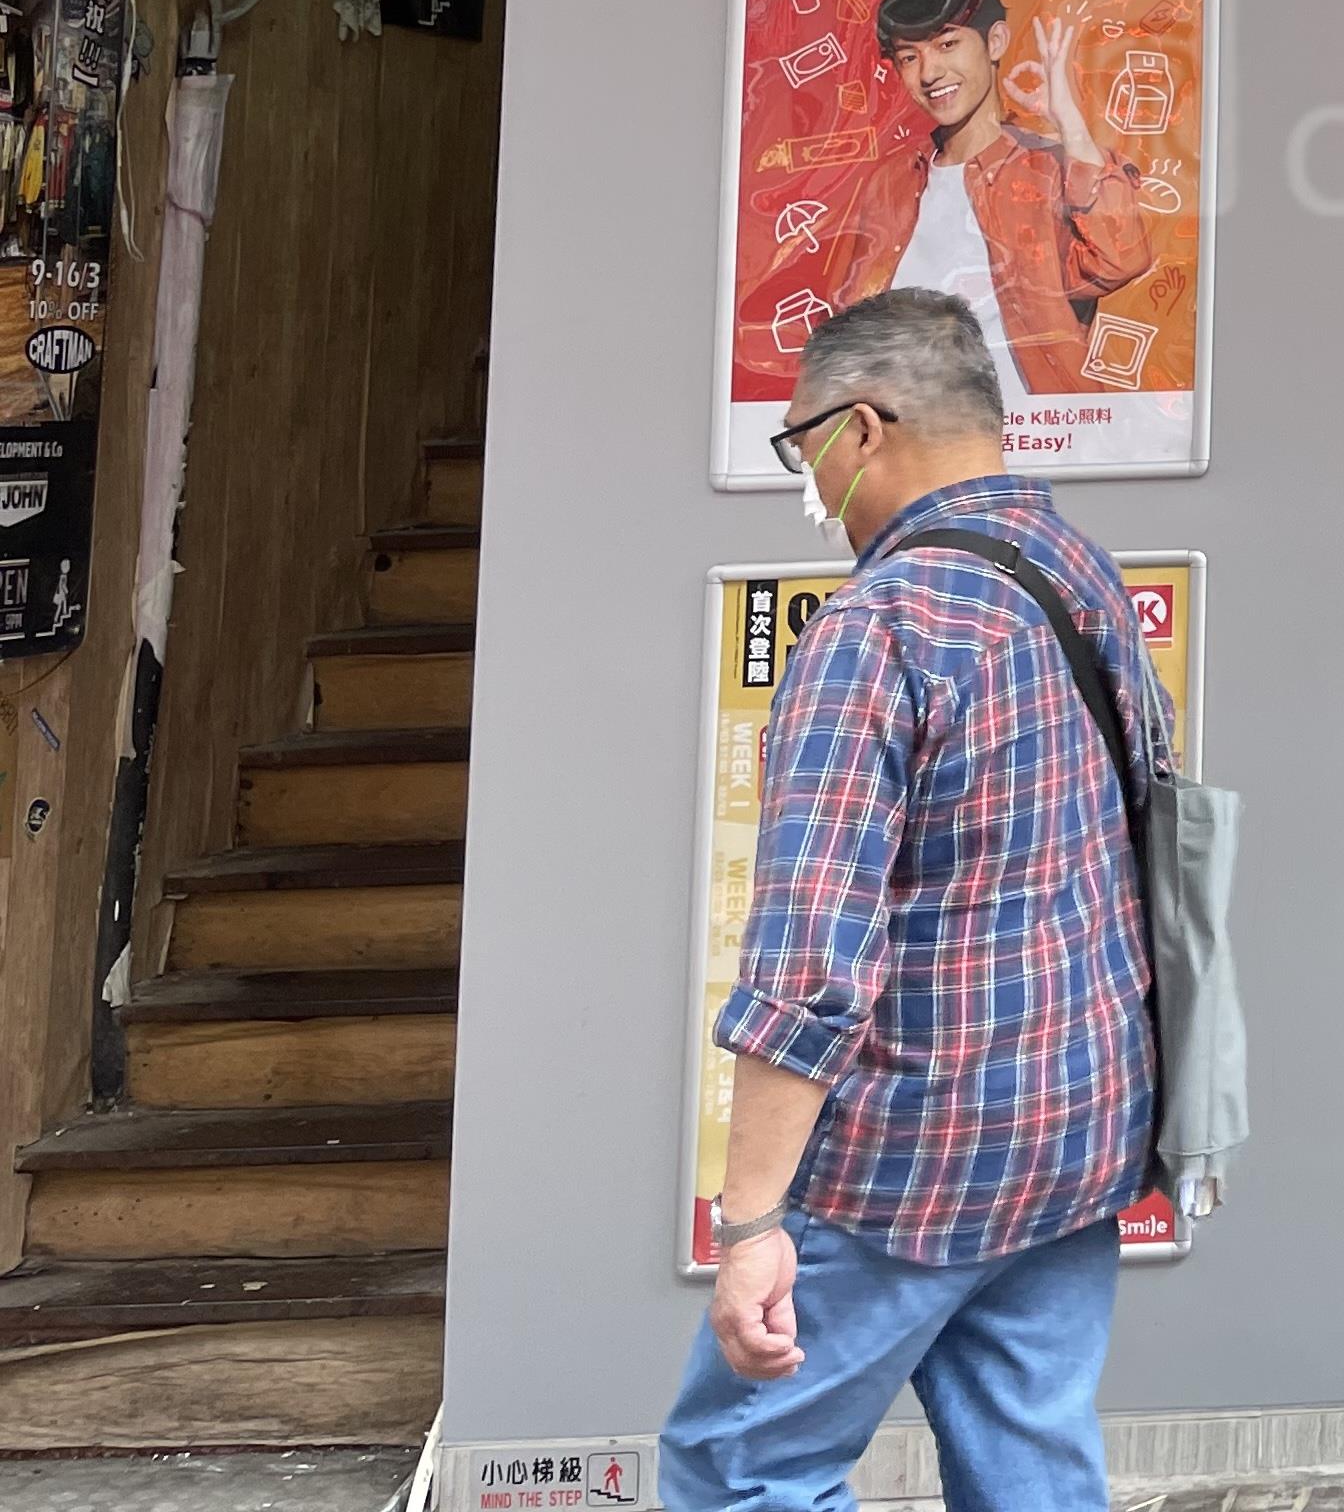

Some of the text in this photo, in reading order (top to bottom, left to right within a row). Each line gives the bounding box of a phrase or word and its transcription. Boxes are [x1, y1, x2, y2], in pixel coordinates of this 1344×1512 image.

[32, 259, 101, 290] 9-16/3
[30, 300, 99, 321] 10% OFF
[29, 329, 93, 371] CRAFTMAN
[1, 483, 45, 510] JOHN
[747, 590, 774, 684] 首次登陸
[730, 722, 753, 789] WEEK
[726, 857, 749, 926] WEEK
[481, 1456, 582, 1487] 小心梯級
[480, 1489, 582, 1509] MIND THE STEP
